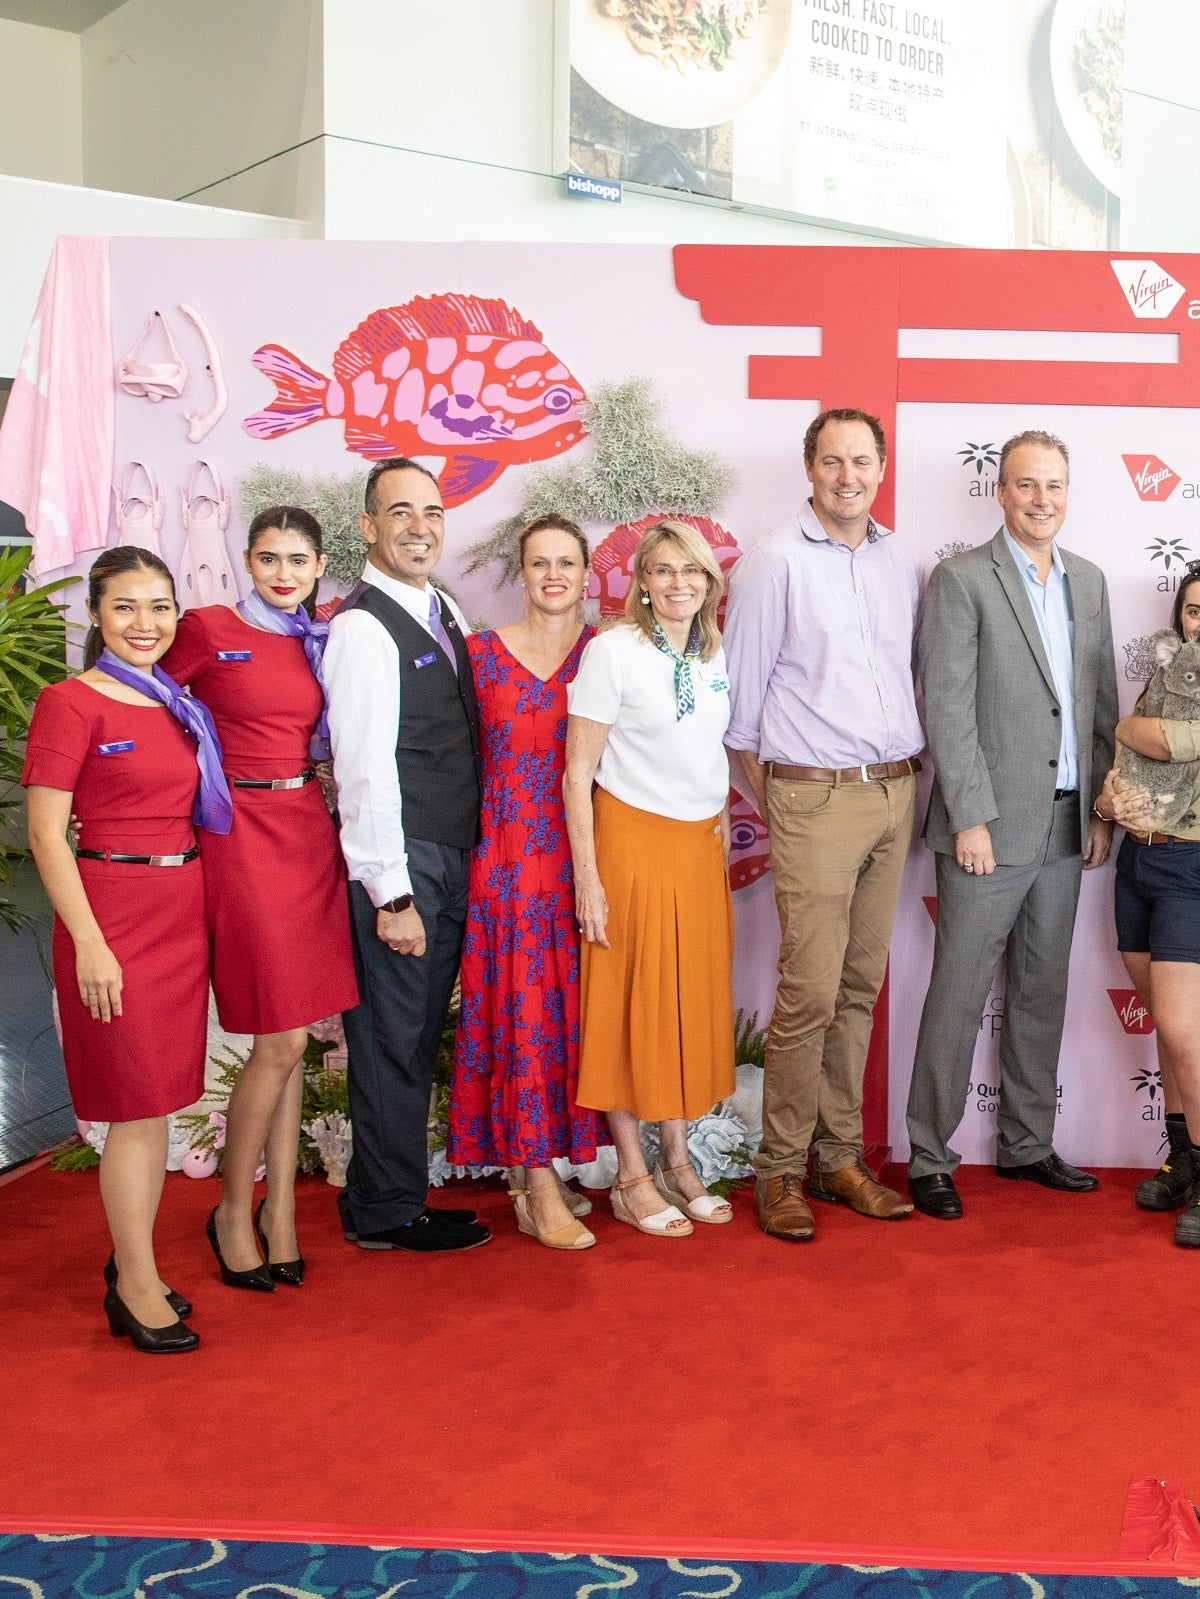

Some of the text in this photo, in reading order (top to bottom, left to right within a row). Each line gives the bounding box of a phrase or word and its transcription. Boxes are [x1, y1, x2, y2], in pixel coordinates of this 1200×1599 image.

[863, 0, 898, 30] FAST.
[906, 9, 952, 46] LOCAL.
[811, 19, 944, 77] COOKED TO ORDER
[568, 176, 620, 201] bishopp
[1128, 269, 1174, 310] Virgin
[1135, 461, 1173, 496] Virgin
[1120, 995, 1149, 1029] Virg
